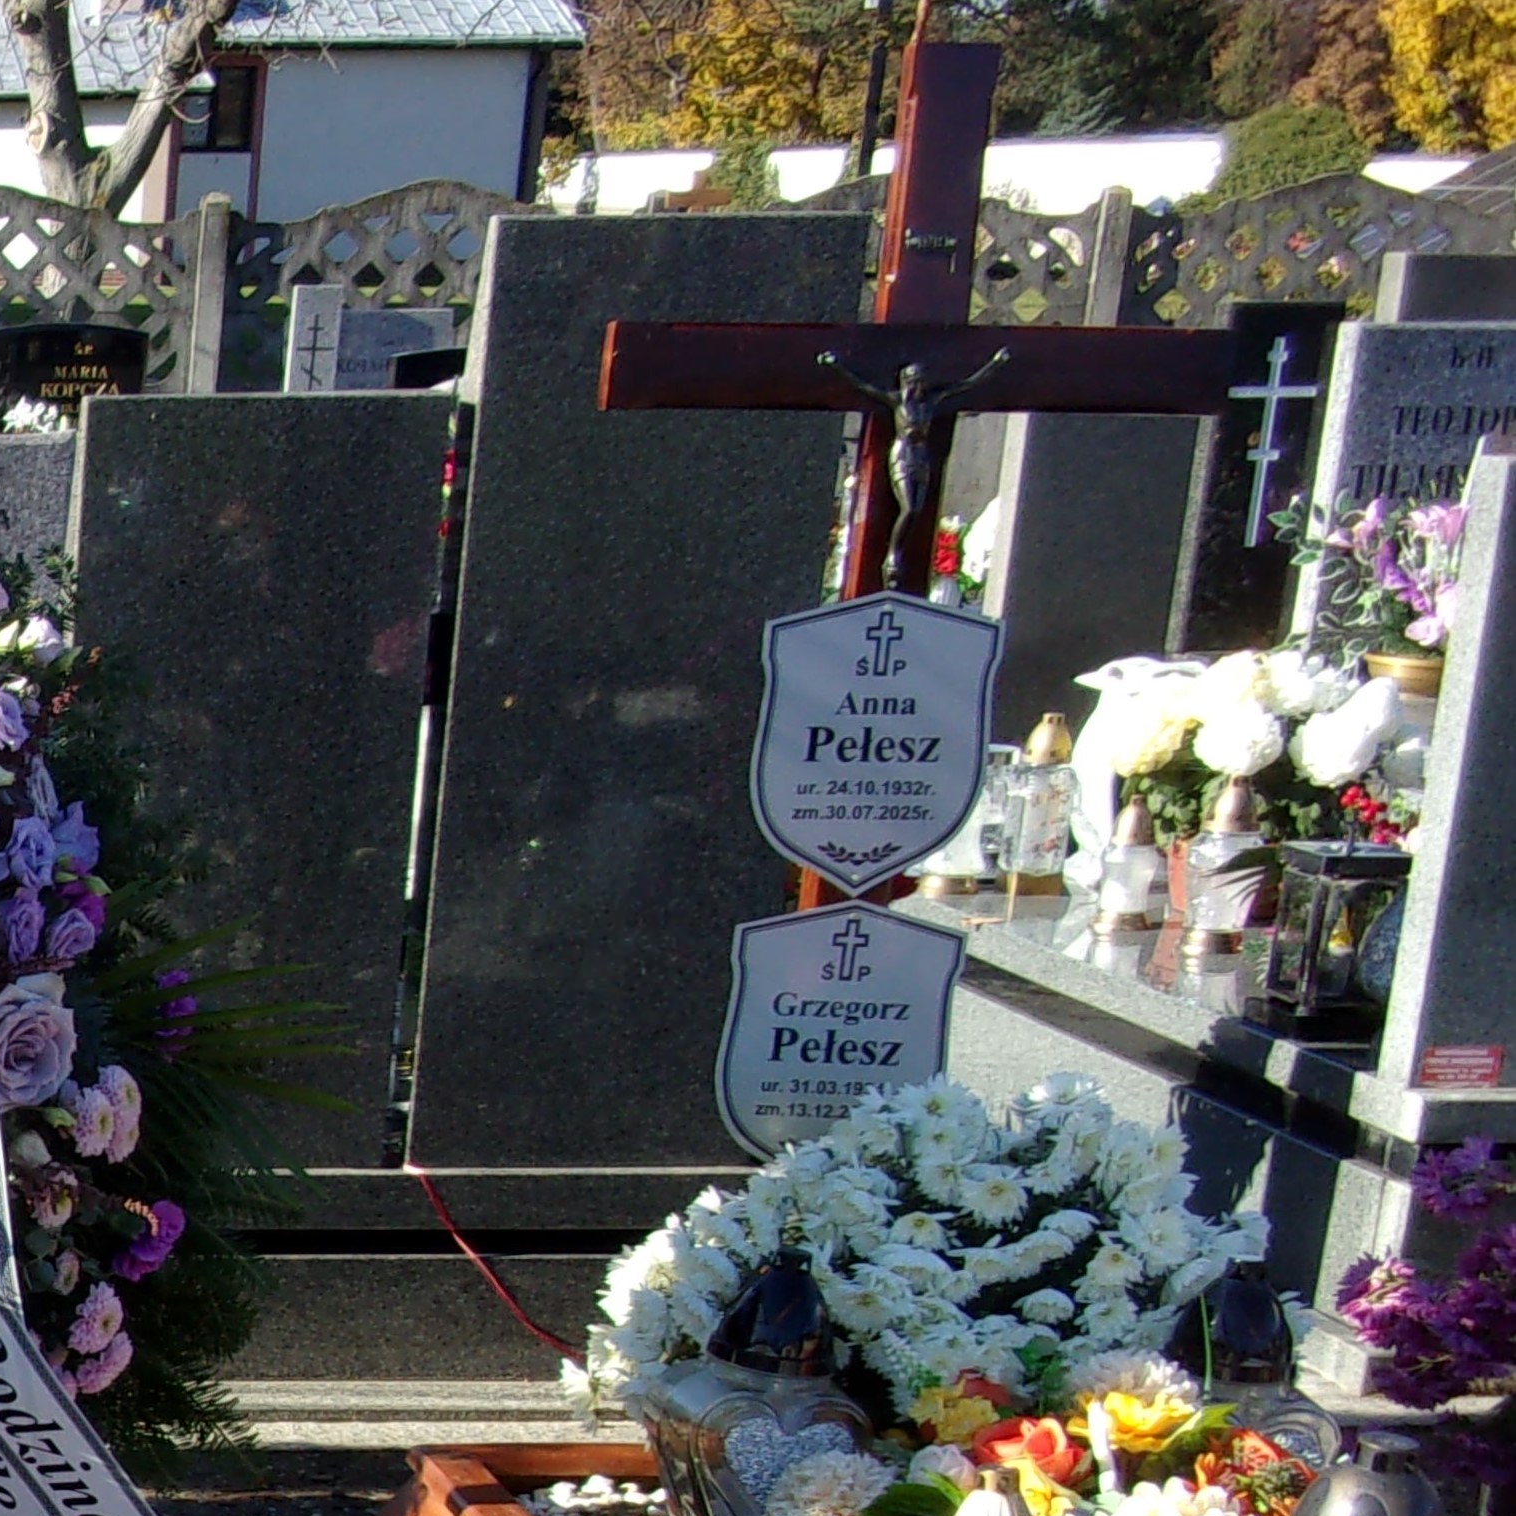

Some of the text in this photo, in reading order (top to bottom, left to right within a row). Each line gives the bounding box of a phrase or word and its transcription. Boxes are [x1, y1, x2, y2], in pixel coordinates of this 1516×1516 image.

[54, 365, 109, 380] MARIA
[892, 659, 907, 677] P
[835, 691, 916, 715] Anna
[803, 726, 941, 763] Pełesz
[796, 780, 937, 797] ur. 24.10.1932r.
[857, 965, 871, 982] P
[772, 991, 910, 1026] Grzegorz
[768, 1026, 904, 1067] Pełesz
[760, 1080, 784, 1093] ur.
